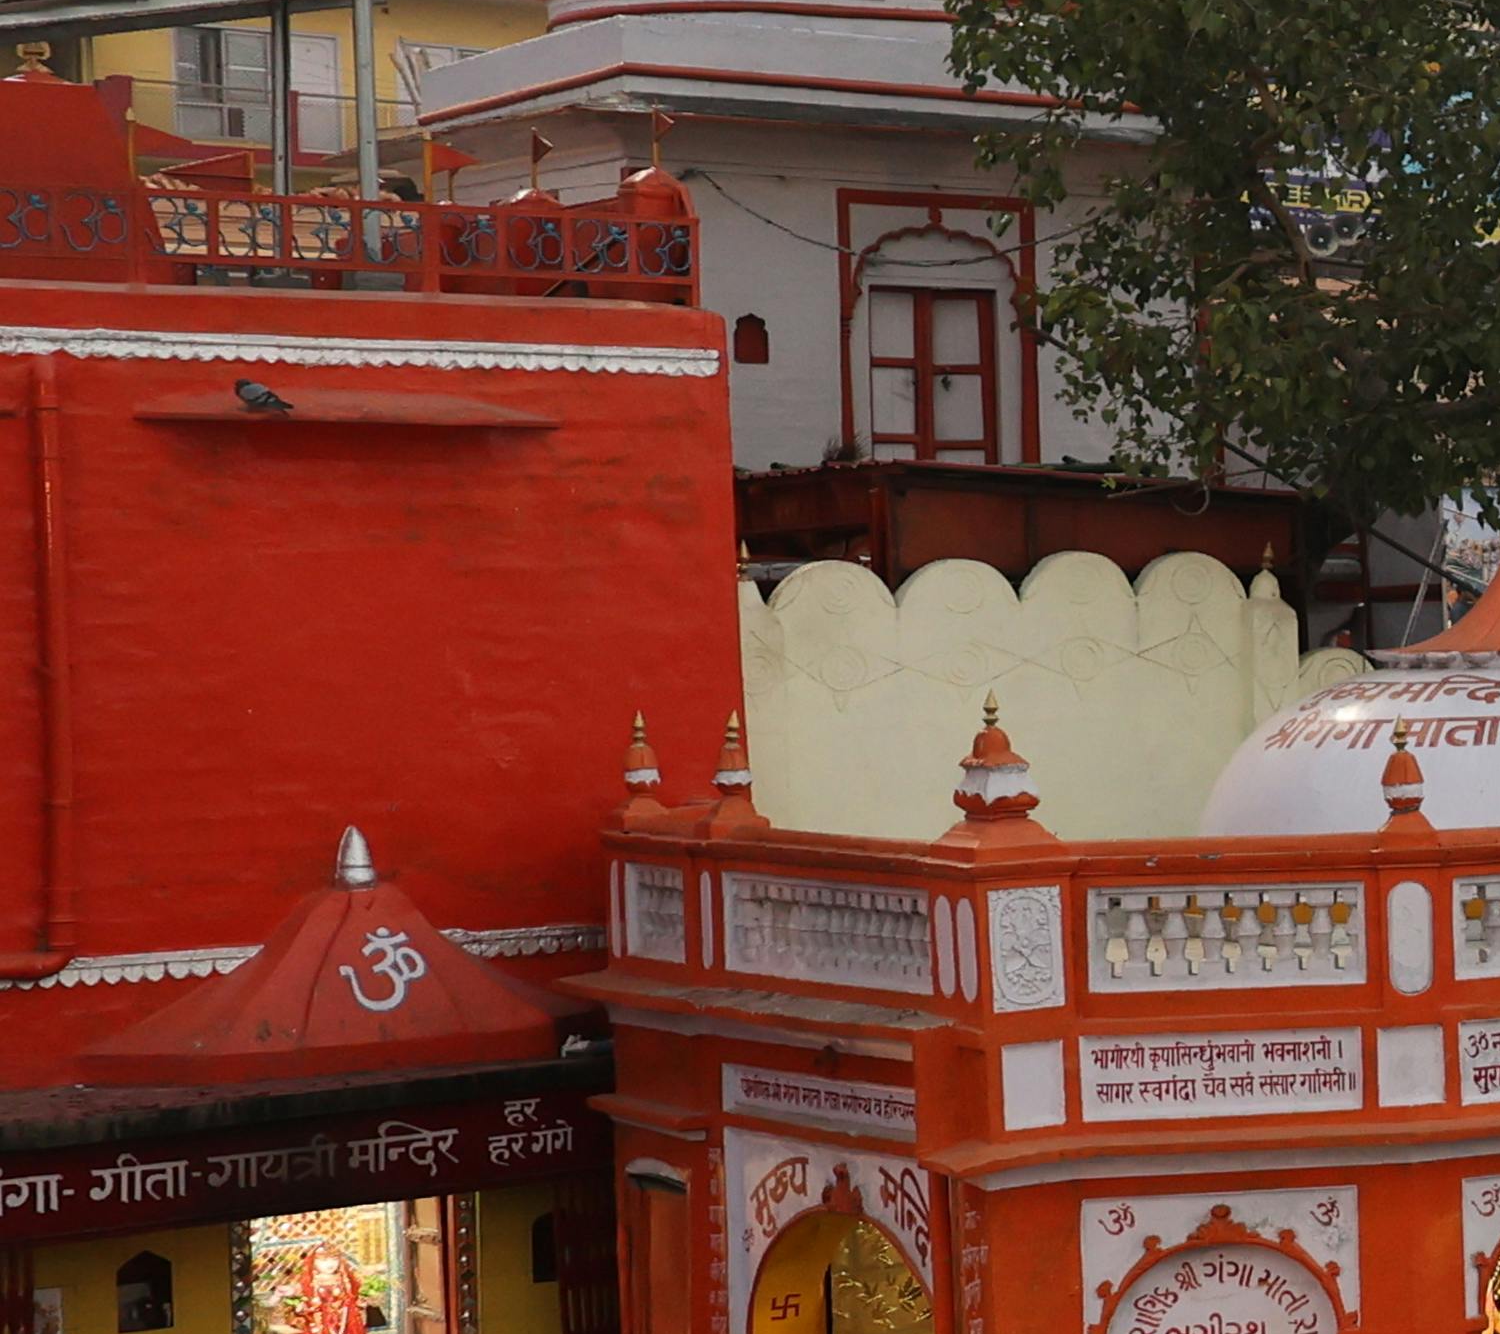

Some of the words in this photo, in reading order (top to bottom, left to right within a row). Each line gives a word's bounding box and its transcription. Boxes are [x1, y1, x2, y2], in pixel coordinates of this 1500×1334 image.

[1091, 1041, 1145, 1070] भागीरथी
[1261, 1038, 1332, 1062] भवनाशनी
[1096, 1082, 1134, 1105] सागर
[1259, 1068, 1297, 1097] संसार
[1299, 1067, 1347, 1094] गामिनी
[503, 1097, 541, 1126] हर
[347, 1120, 459, 1176] मन्दिर
[487, 1131, 526, 1167] हर
[528, 1119, 574, 1156] गंगे
[750, 1156, 810, 1239] मुख्य
[878, 1166, 932, 1268] मन्दि
[1173, 1261, 1203, 1292] શ્રી
[1202, 1253, 1254, 1288] ગંગા
[1257, 1268, 1310, 1317] માતા
